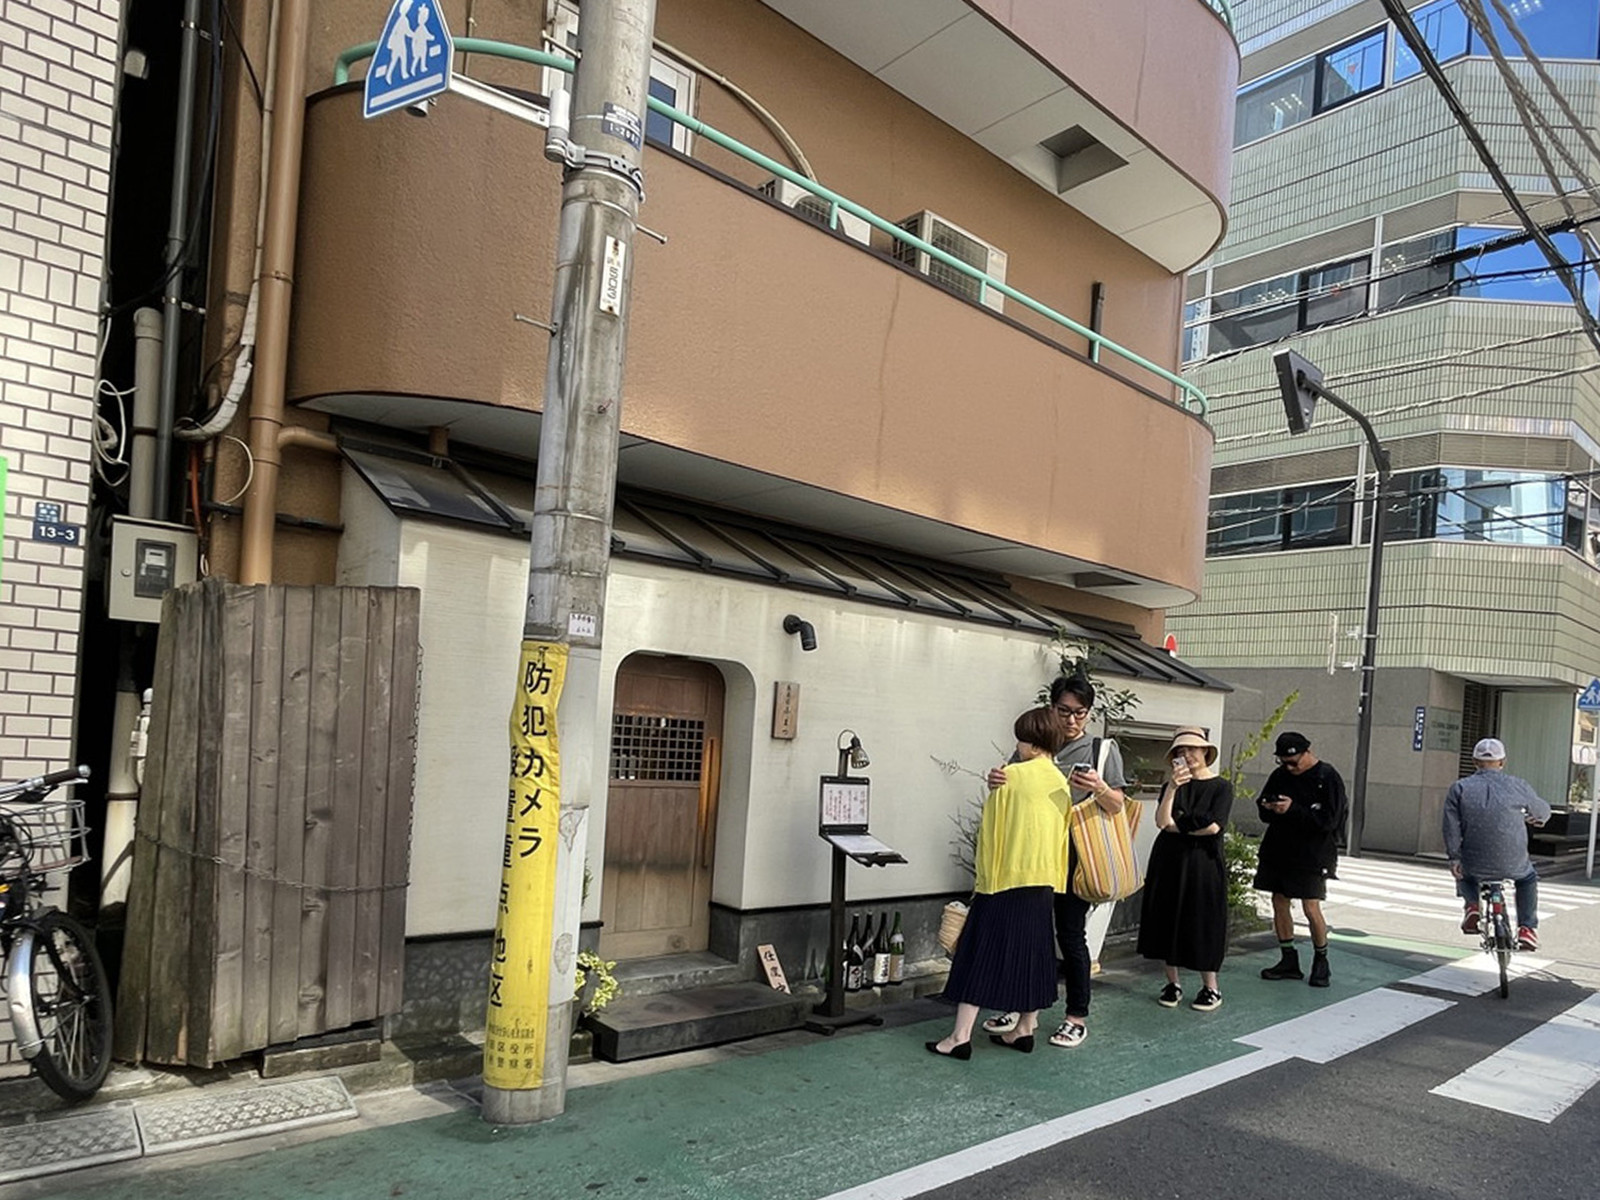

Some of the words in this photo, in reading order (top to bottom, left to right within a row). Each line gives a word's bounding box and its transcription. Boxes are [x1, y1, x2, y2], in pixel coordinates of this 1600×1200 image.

[39, 525, 75, 541] 13-3
[518, 660, 553, 858] 防犯カメラ
